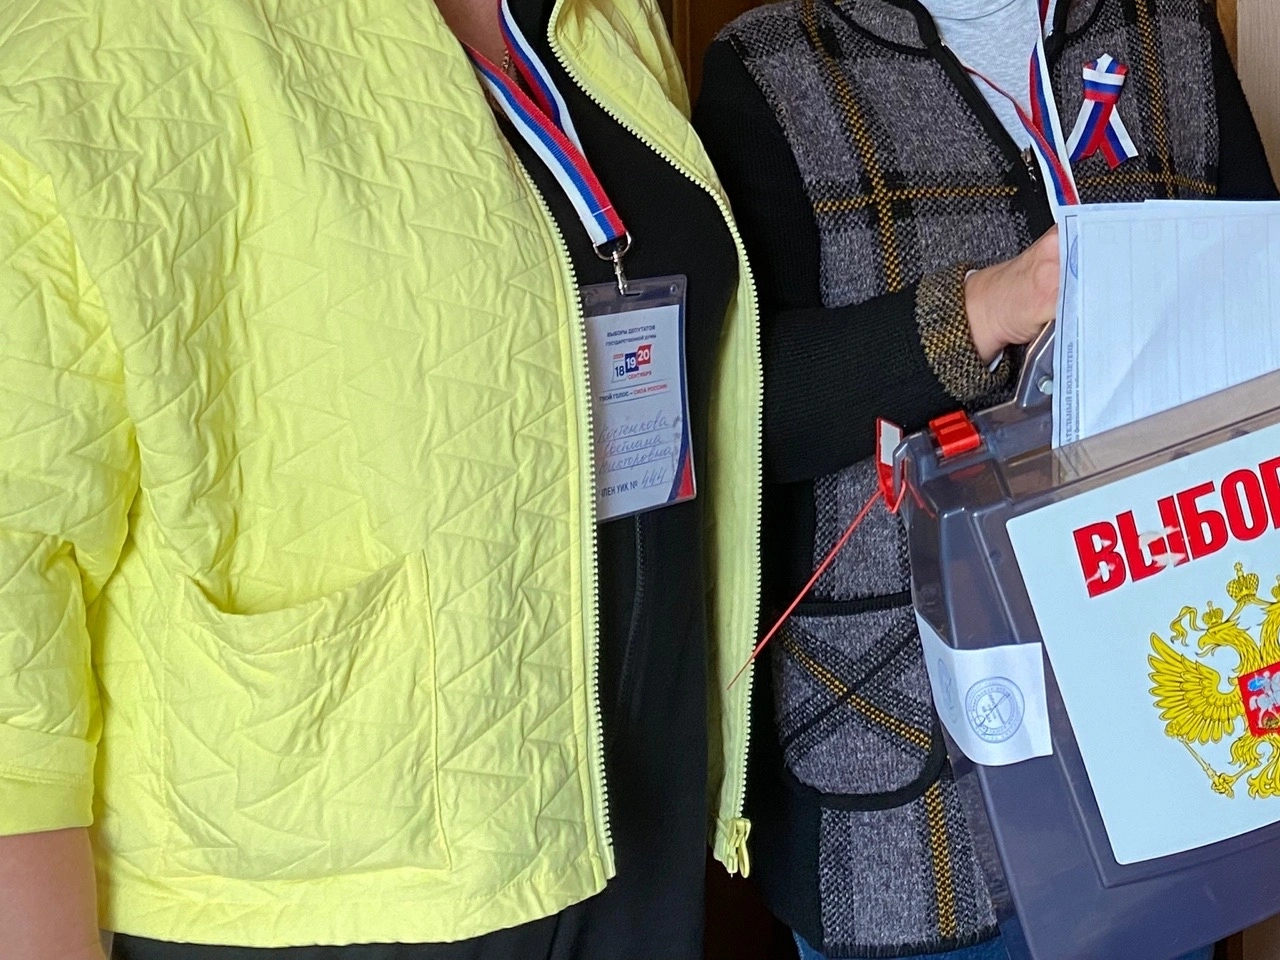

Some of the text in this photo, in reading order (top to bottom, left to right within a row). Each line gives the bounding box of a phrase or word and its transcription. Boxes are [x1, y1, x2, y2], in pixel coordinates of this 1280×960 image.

[628, 324, 656, 335] ДЕПУТАТОВ
[615, 348, 650, 377] 18 19 20
[613, 390, 629, 400] ГОЛОС
